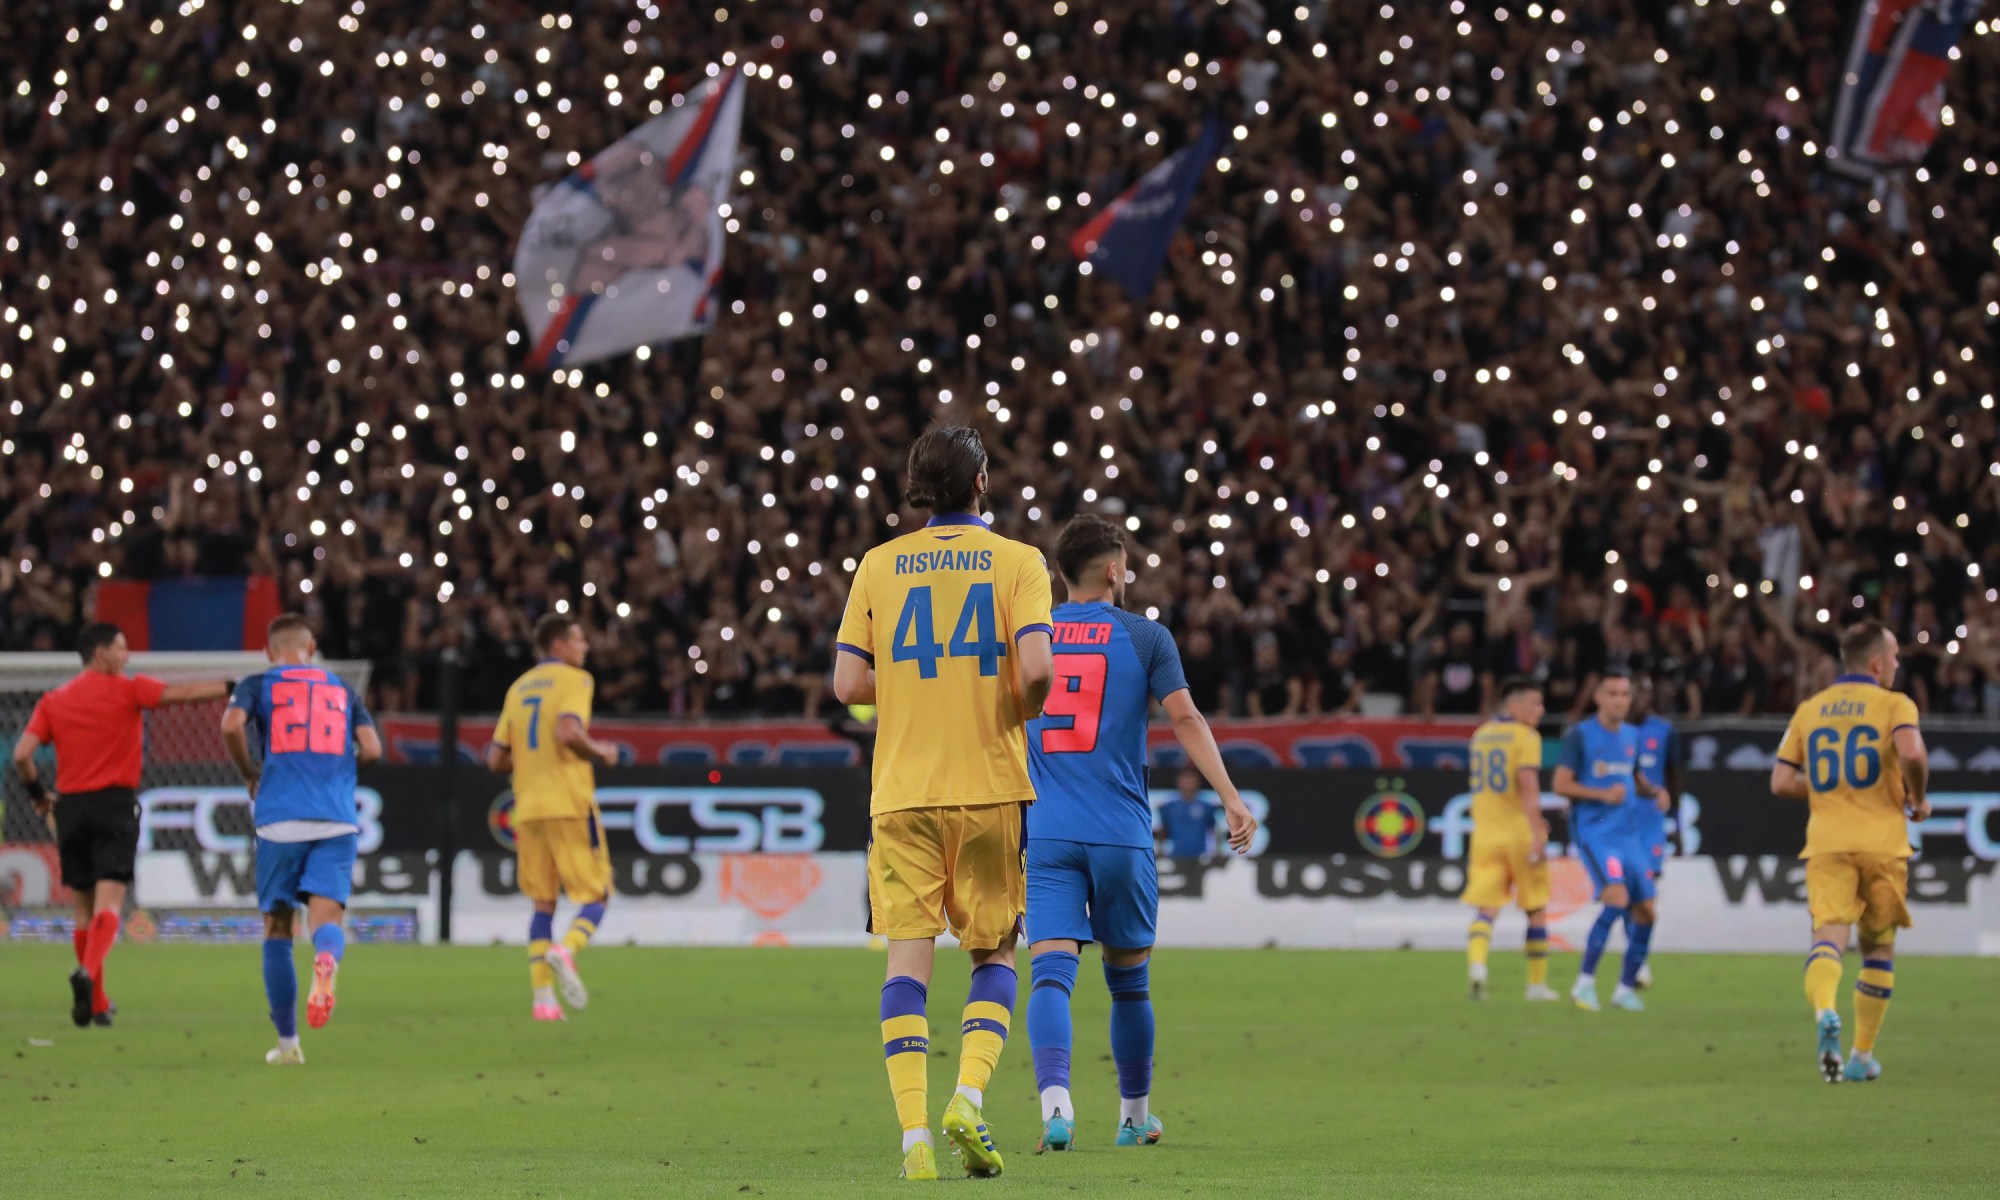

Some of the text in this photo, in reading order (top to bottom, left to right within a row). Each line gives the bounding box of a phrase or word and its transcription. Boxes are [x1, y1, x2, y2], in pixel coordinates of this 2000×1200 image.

[895, 549, 993, 575] RISVANIS
[891, 582, 1007, 680] 44
[1053, 622, 1112, 645] TOICA
[270, 681, 348, 756] 26
[522, 697, 543, 751] 7
[1041, 653, 1108, 753] 9
[1807, 725, 1881, 793] 66
